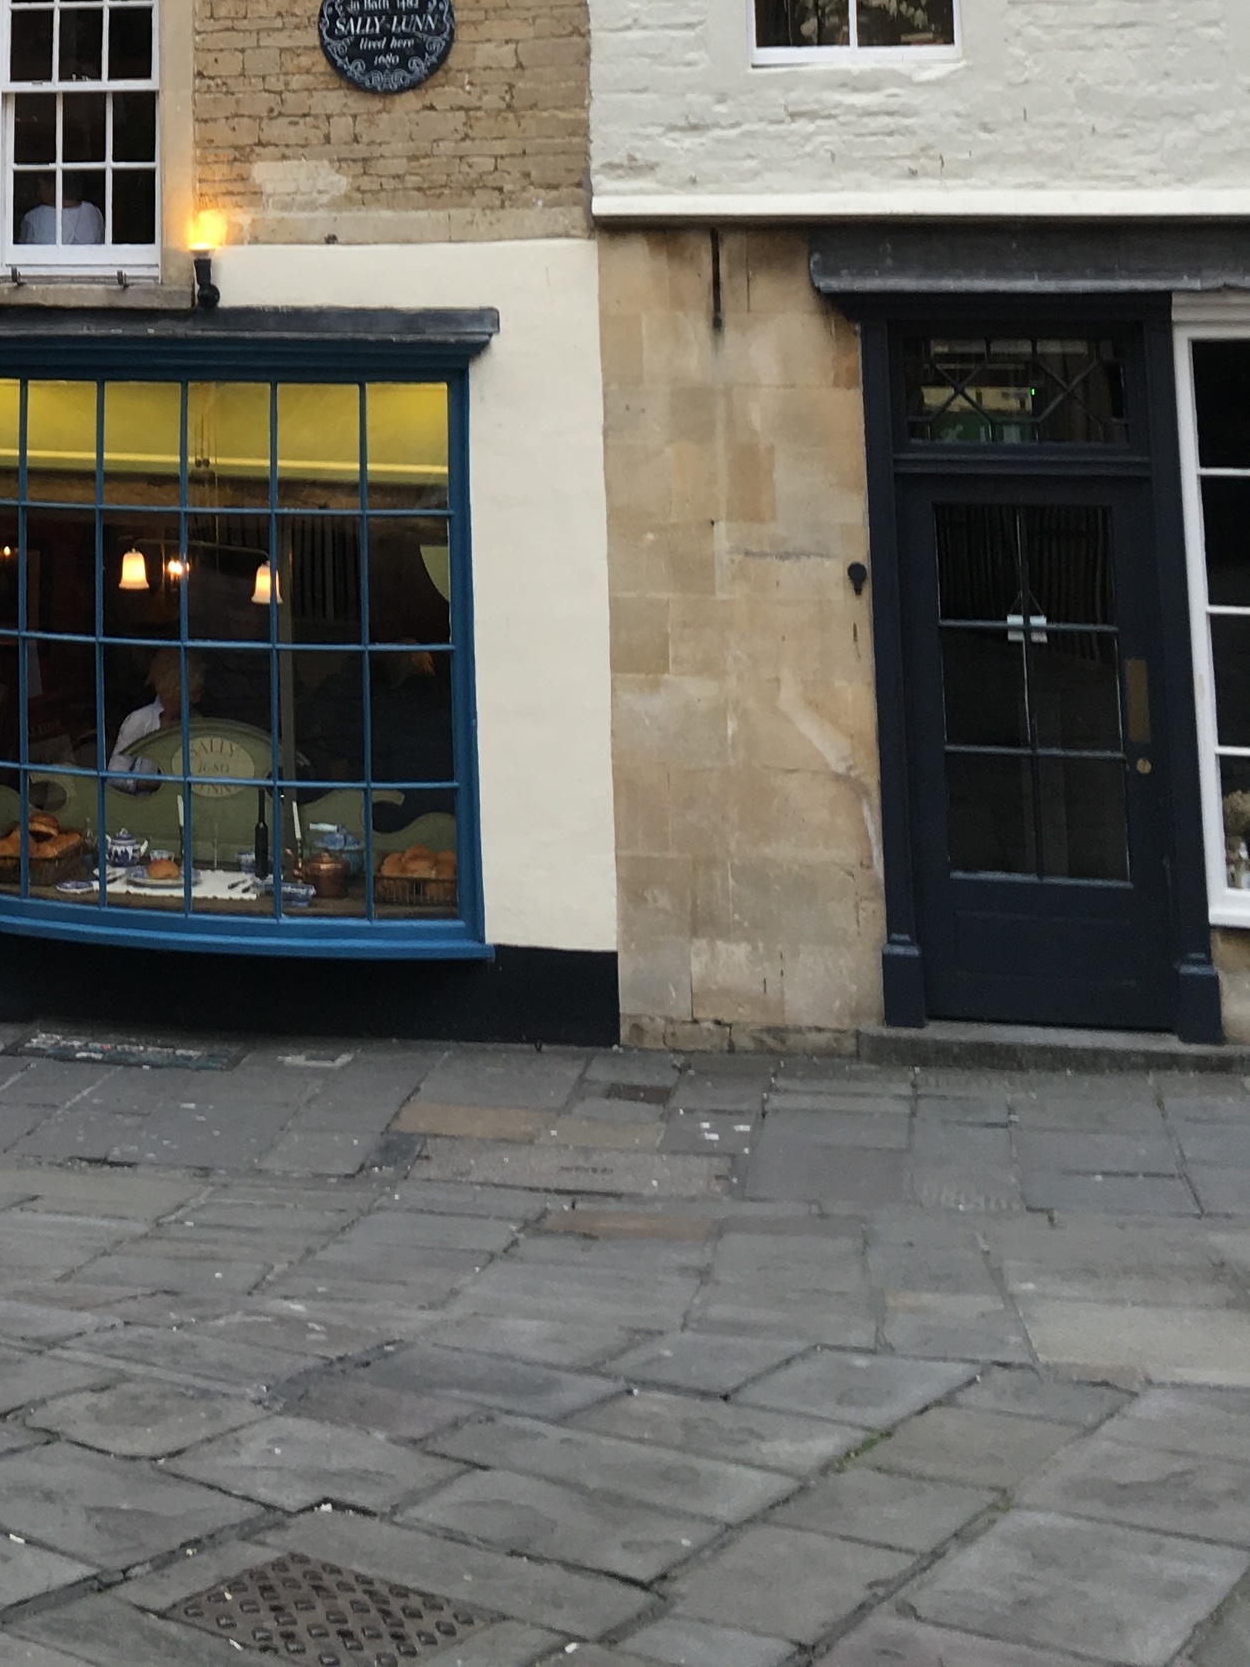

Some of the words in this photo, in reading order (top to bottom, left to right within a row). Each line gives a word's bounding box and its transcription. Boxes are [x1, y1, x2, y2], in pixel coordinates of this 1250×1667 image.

[335, 15, 385, 34] SALLY
[392, 15, 437, 32] LUNN
[359, 36, 387, 50] lived
[390, 36, 414, 49] here
